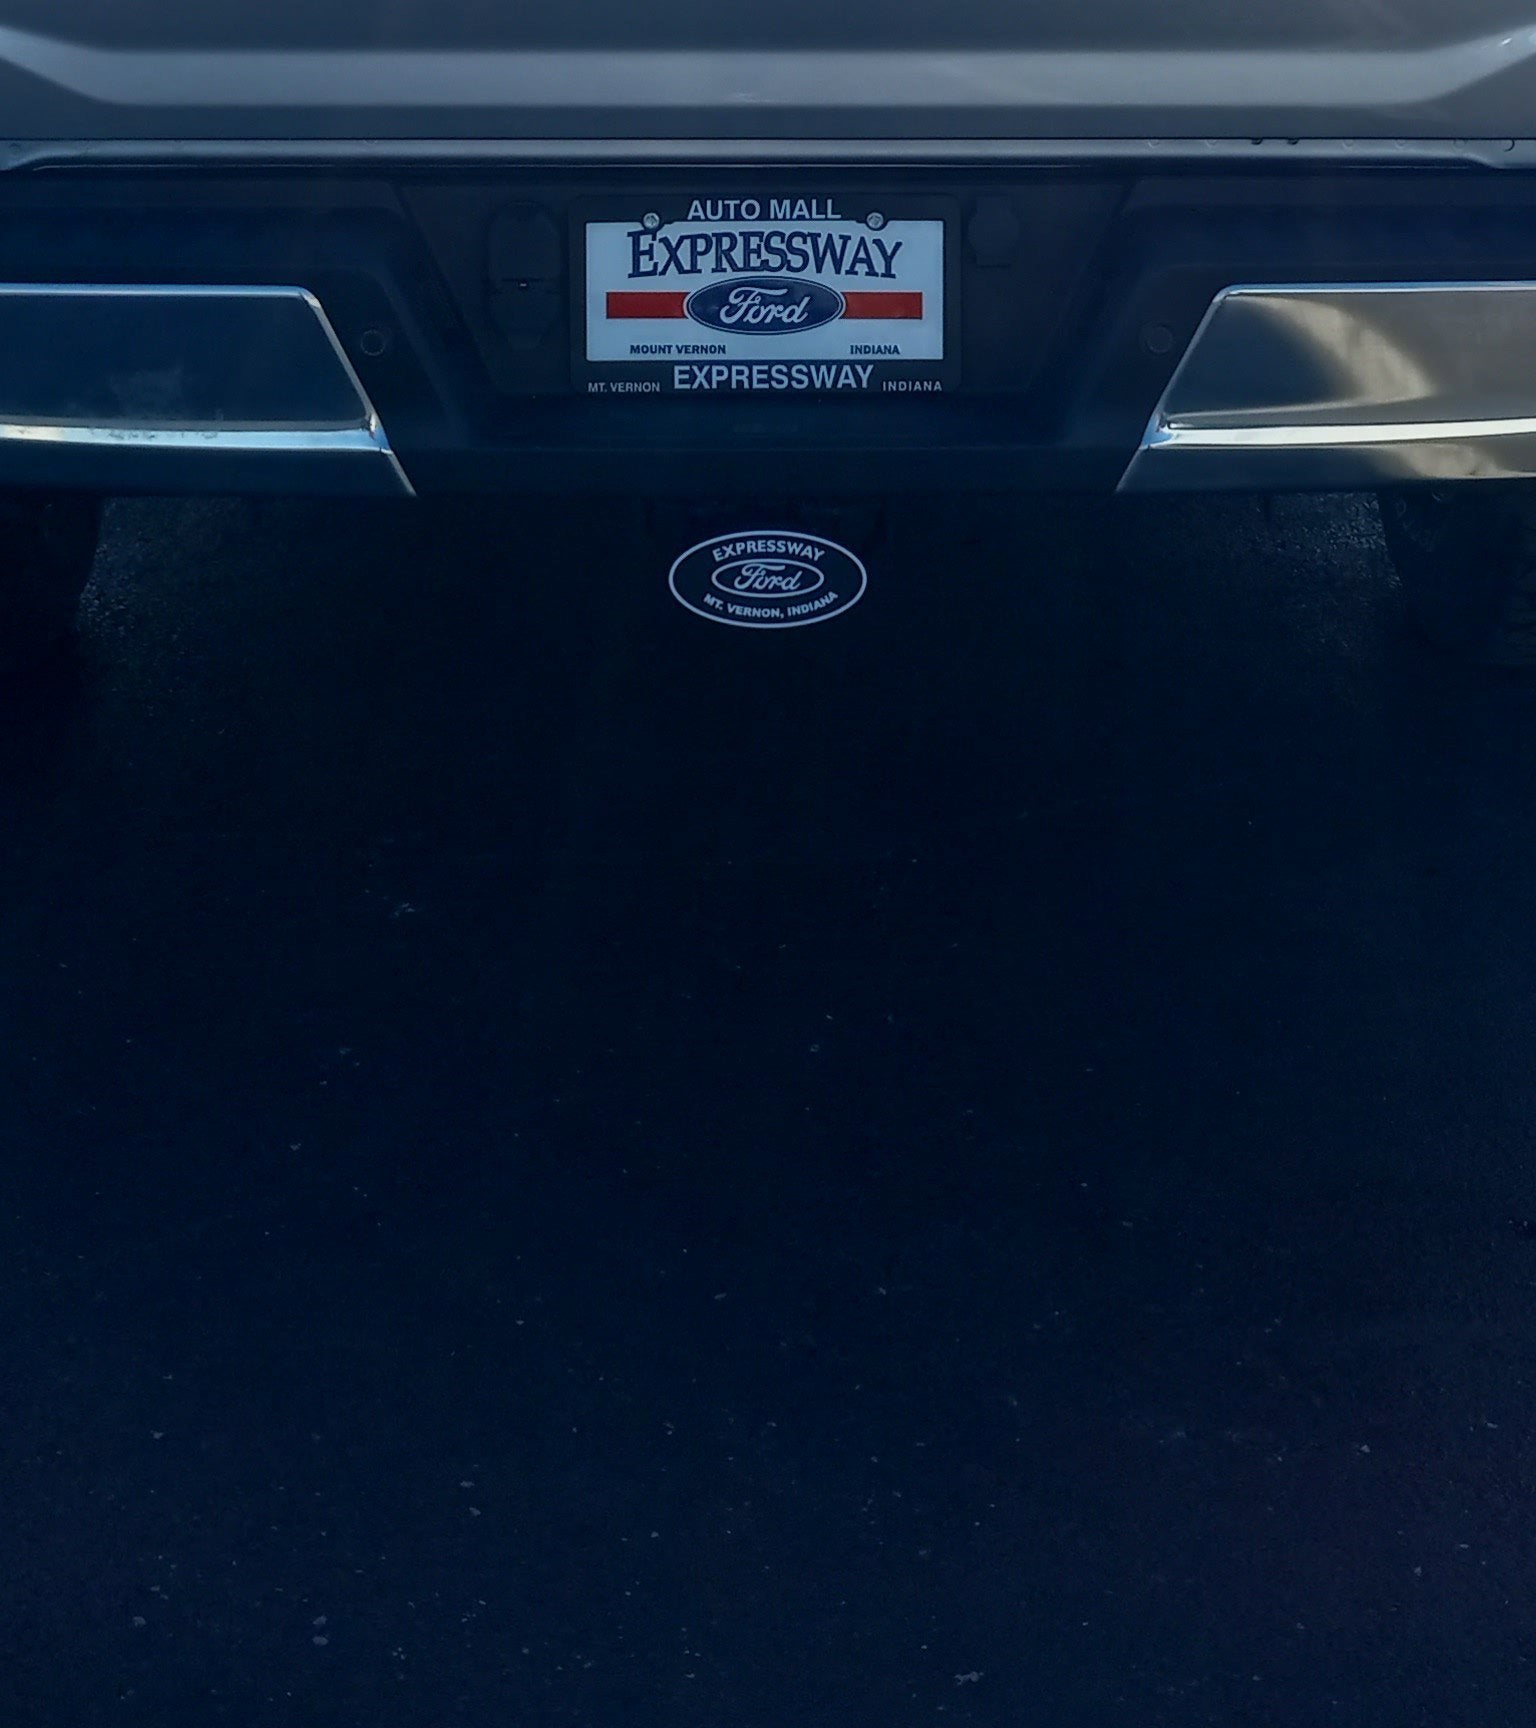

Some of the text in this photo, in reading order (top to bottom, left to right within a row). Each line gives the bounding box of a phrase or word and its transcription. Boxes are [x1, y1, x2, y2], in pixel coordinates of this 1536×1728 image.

[686, 198, 842, 221] AUTO MALL
[626, 229, 904, 280] EXPRESSWAY
[719, 286, 810, 325] Ford
[629, 344, 901, 355] MOUNT VERNON INDIANA
[588, 364, 943, 393] MT. VERNON EXPRESSWAY INDIANA
[712, 539, 826, 562] EXPRESSWAY
[733, 562, 803, 591] Ford
[703, 591, 839, 619] MT. VERNON, INDIANA
